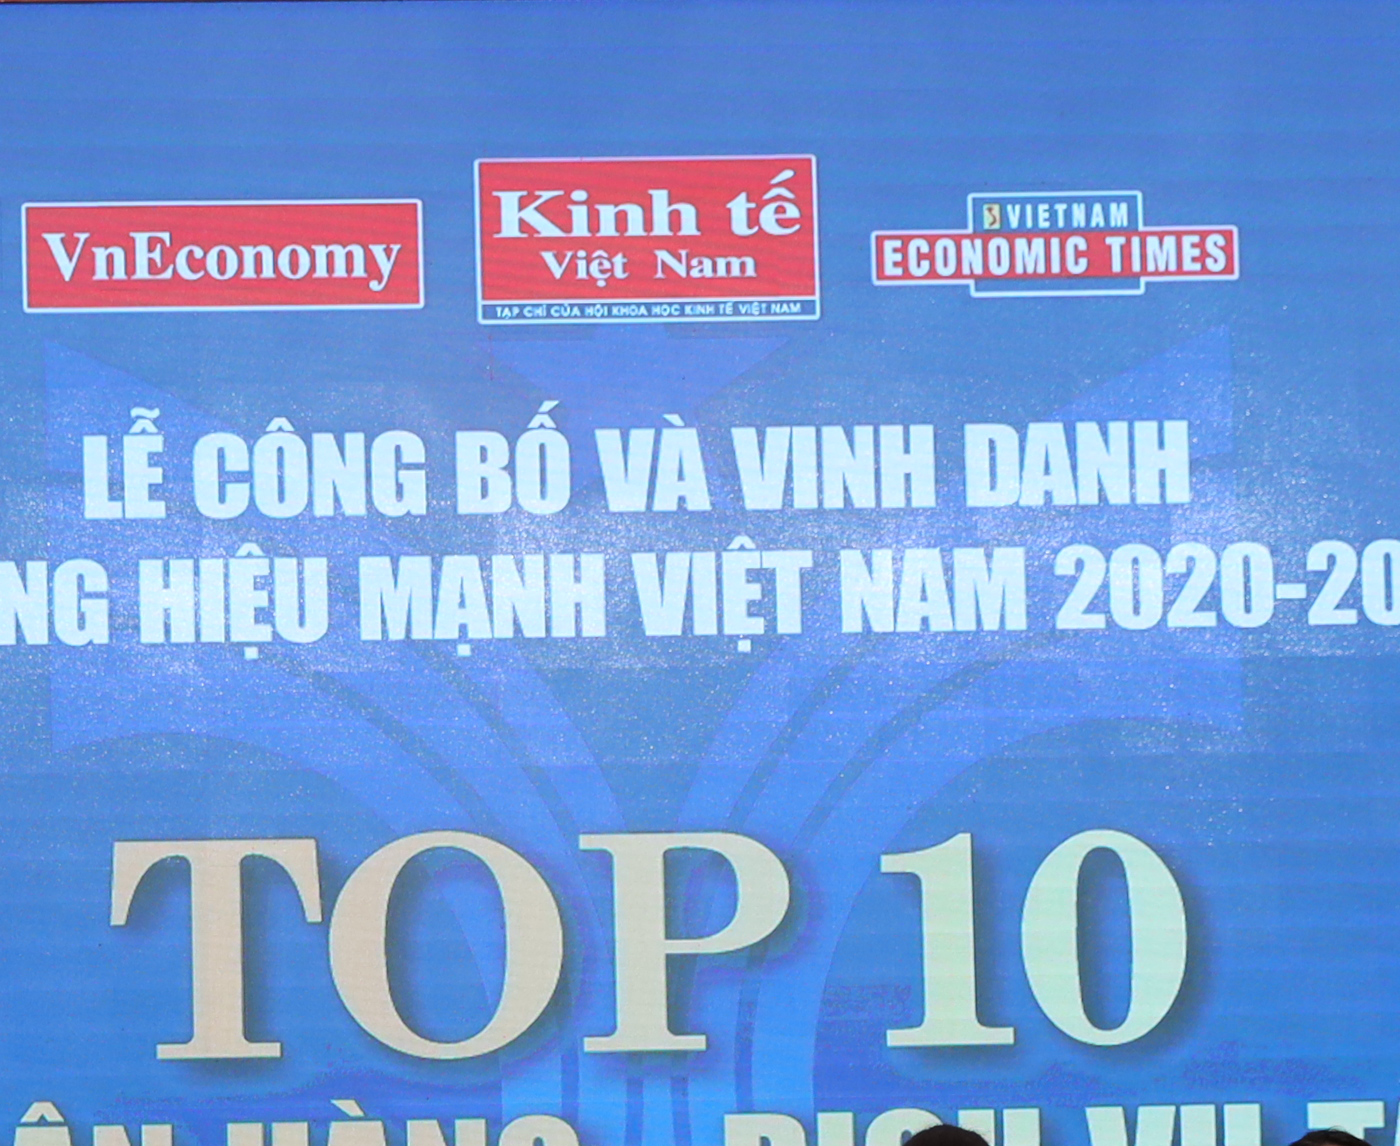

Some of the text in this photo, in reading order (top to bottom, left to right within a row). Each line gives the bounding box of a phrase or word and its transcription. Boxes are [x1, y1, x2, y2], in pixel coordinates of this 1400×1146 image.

[493, 170, 802, 238] Kinh tế
[1007, 202, 1128, 228] VIETNAM
[43, 231, 401, 291] VnEconomy
[539, 247, 757, 288] Việt Nam
[883, 233, 1227, 277] ECONOMIC TIMES
[612, 305, 648, 316] KHOA
[684, 304, 714, 316] KINH
[771, 303, 801, 314] NAM
[82, 400, 1191, 520] LỄ CÔNG BỐ VÀ VINH DANH
[138, 542, 329, 659] HIỆU
[359, 552, 606, 656] MẠNH
[631, 535, 814, 653] VIỆT
[840, 545, 1028, 633] NAM
[109, 826, 1187, 1060] TOP 10
